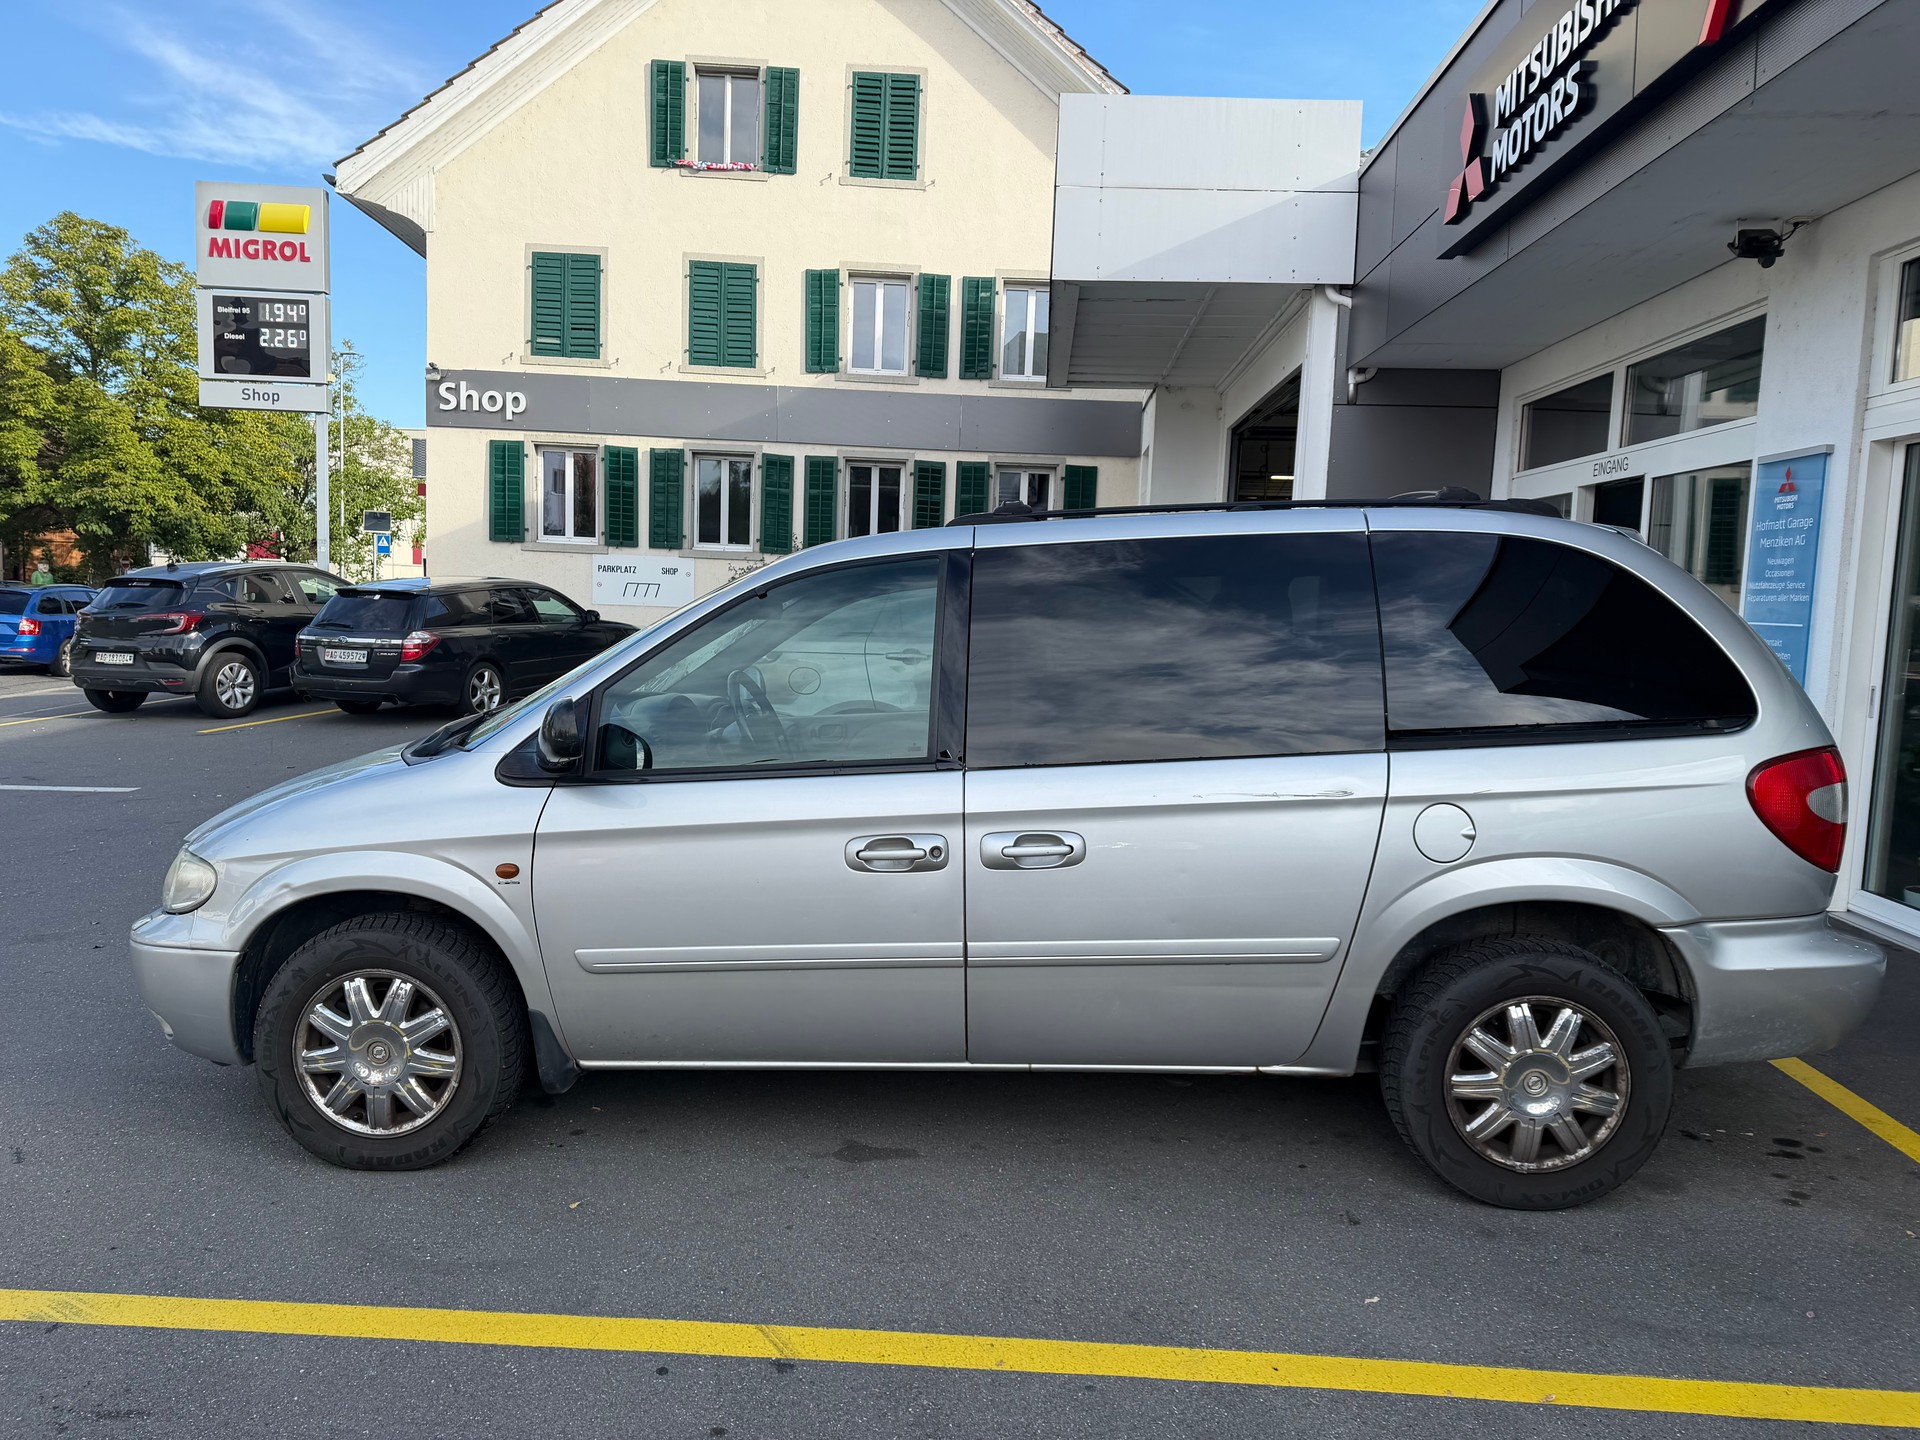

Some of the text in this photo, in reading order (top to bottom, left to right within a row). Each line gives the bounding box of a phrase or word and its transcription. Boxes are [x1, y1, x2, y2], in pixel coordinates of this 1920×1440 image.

[1494, 0, 1621, 128] MITSUBIS
[1490, 61, 1581, 183] MOTORS
[208, 237, 311, 262] MIGROL
[224, 332, 245, 340] Diesel
[241, 388, 280, 405] Shop
[438, 381, 527, 420] Shop
[1593, 456, 1629, 477] EINGANG
[1774, 494, 1798, 503] MITSUBISHI
[1776, 502, 1795, 510] MOTORS
[1756, 517, 1814, 531] Hofmatt Garage
[1760, 534, 1806, 548] Menziken AG
[1767, 557, 1794, 566] Neuwagen
[597, 565, 679, 576] PARKPLATZ SHOP
[1765, 569, 1794, 578] Occasionen
[1786, 581, 1806, 589] Service
[1778, 593, 1789, 602] aller
[1790, 593, 1810, 602] Marken
[1586, 978, 1660, 1051] RADAR
